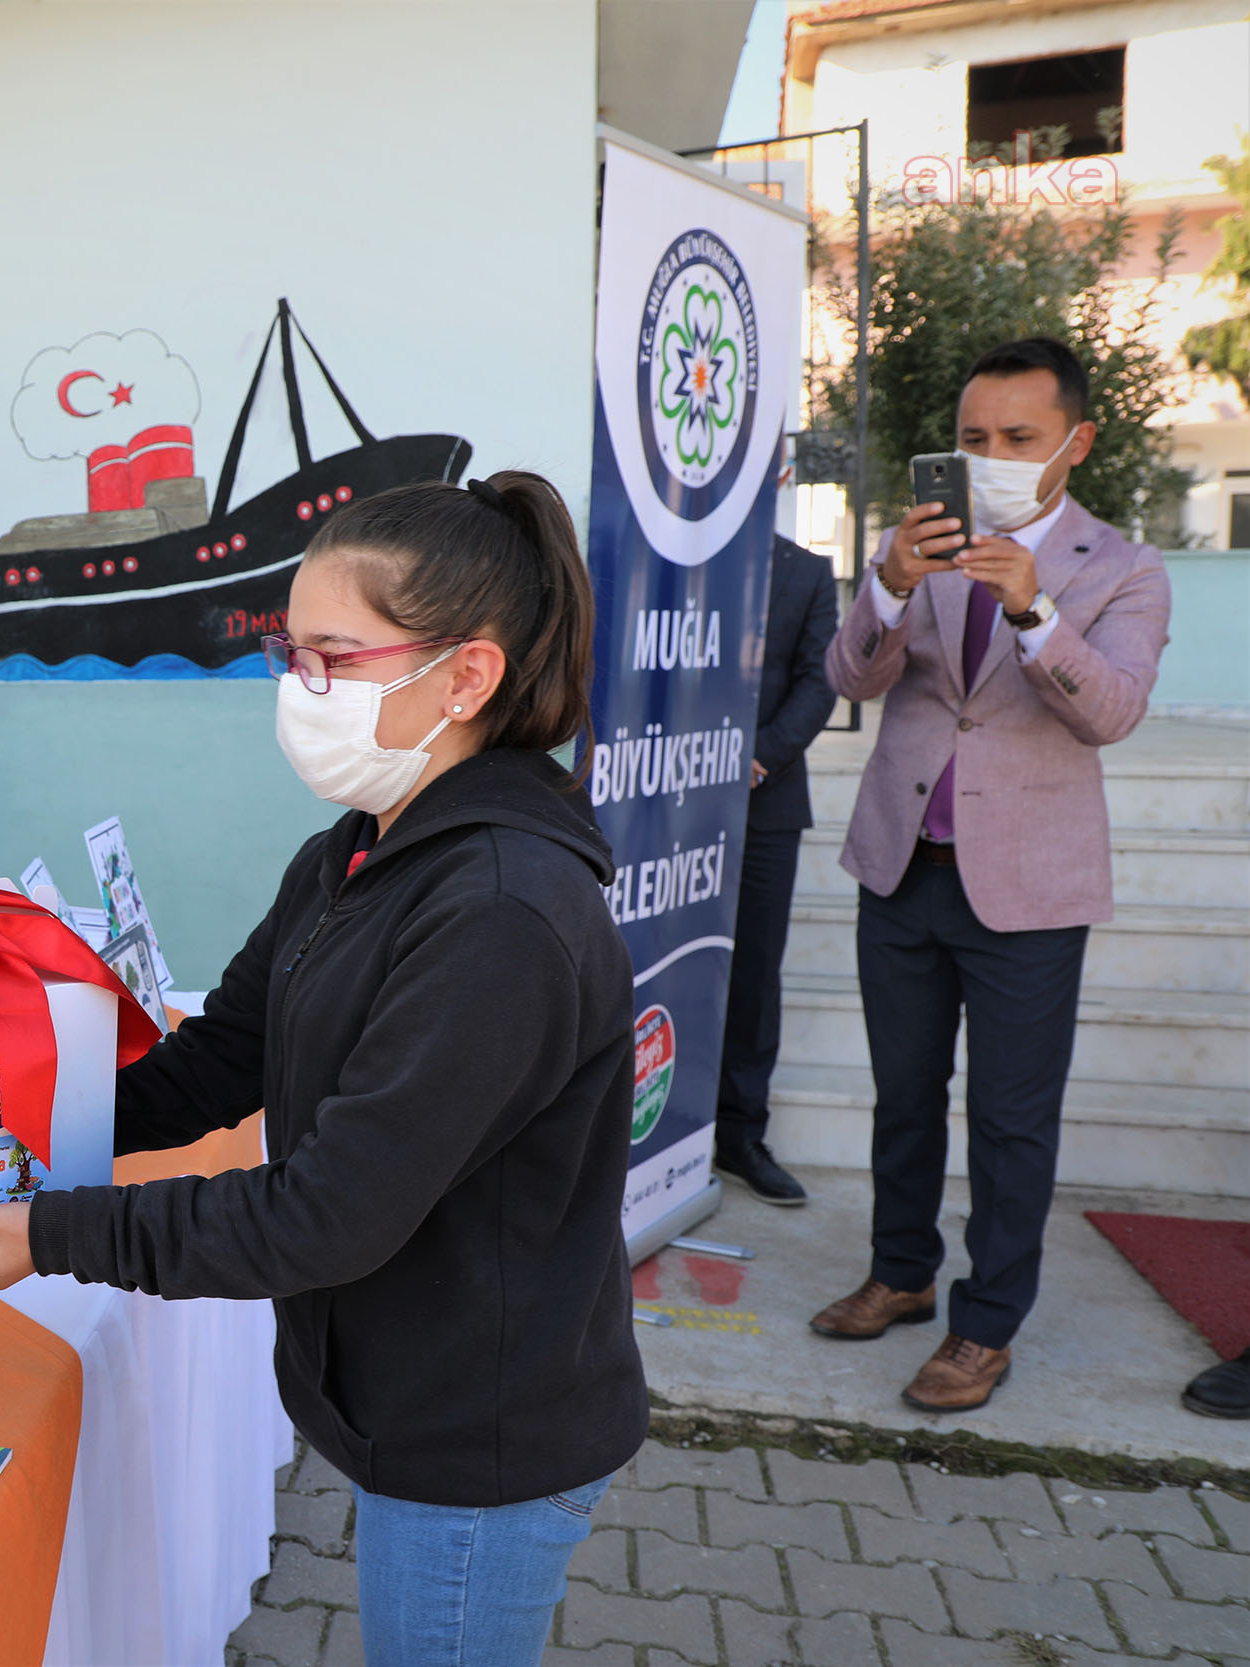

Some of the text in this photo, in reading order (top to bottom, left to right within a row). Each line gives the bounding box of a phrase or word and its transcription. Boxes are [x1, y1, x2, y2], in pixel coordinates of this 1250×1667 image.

[225, 609, 247, 638] 19
[633, 598, 721, 671] MUĞLA
[590, 716, 744, 807] BÜYÜKŞEHİR
